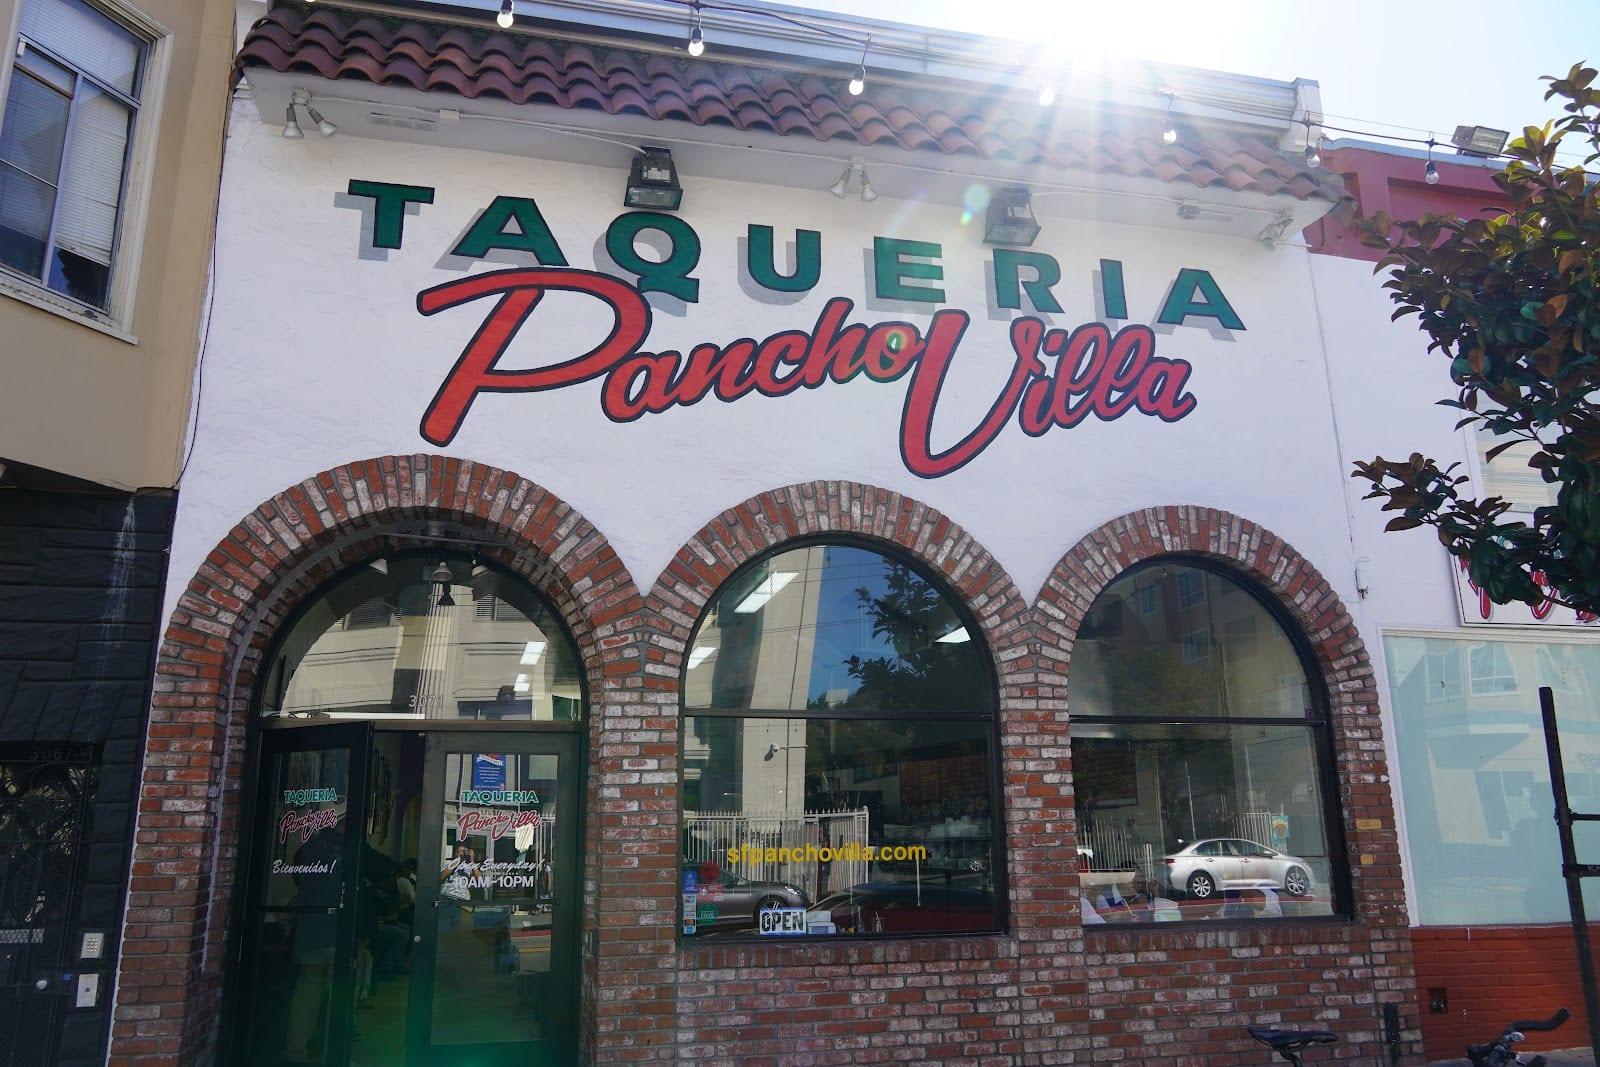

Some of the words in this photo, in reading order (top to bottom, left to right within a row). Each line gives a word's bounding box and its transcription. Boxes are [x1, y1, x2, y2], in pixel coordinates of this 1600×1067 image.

[347, 179, 1246, 331] TAQUERIA
[416, 267, 925, 447] Pancho
[899, 309, 1197, 479] Villa
[408, 694, 443, 708] 3071
[284, 787, 338, 807] TAQUERIA
[462, 790, 540, 806] TAQUERIA
[279, 808, 316, 844] Pancho
[301, 808, 338, 843] Villa
[456, 809, 509, 842] Pancho
[491, 809, 542, 841] Villa
[447, 856, 480, 873] Open
[480, 857, 546, 873] Everyday!
[726, 842, 928, 867] sfpanchovilla.com
[761, 911, 804, 932] OPEN
